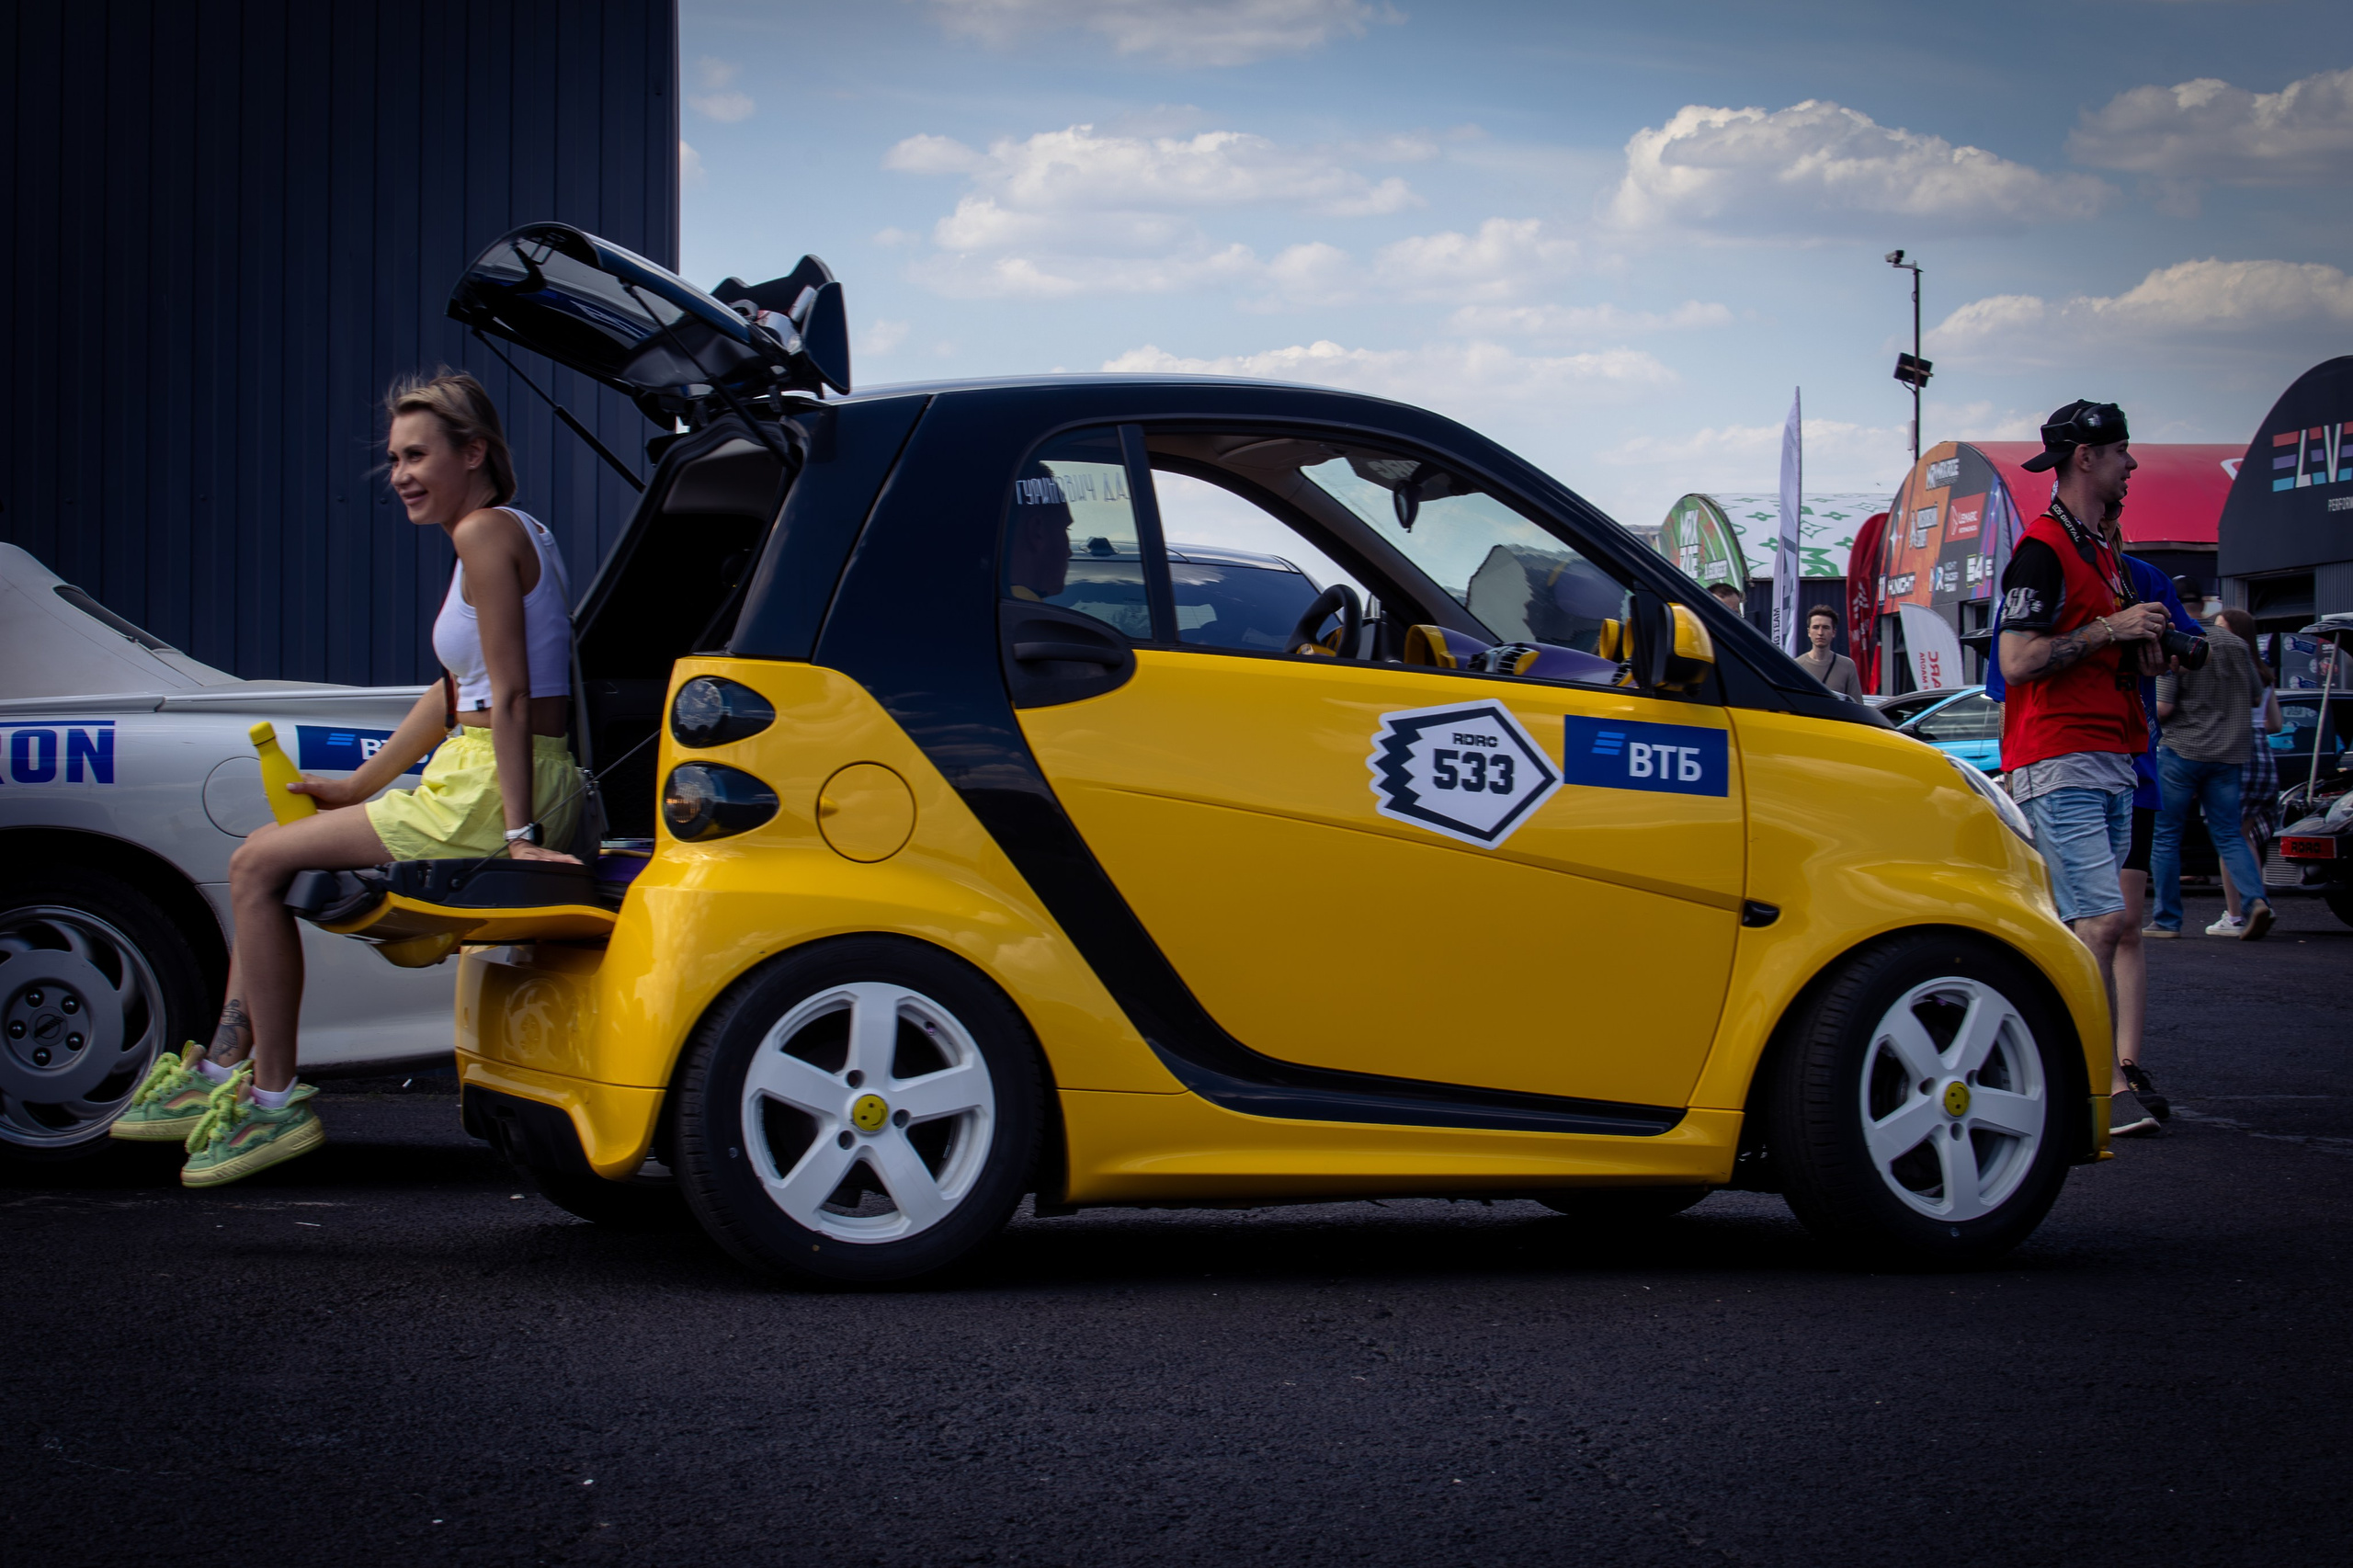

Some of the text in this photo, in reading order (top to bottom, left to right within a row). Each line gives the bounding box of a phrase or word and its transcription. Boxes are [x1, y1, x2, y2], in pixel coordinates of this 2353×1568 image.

[2052, 504, 2080, 542] EOS DIGITAL
[0, 729, 115, 784] ON
[1452, 733, 1498, 748] RDRC
[1432, 748, 1515, 795] 533
[1629, 742, 1702, 782] ВТБ
